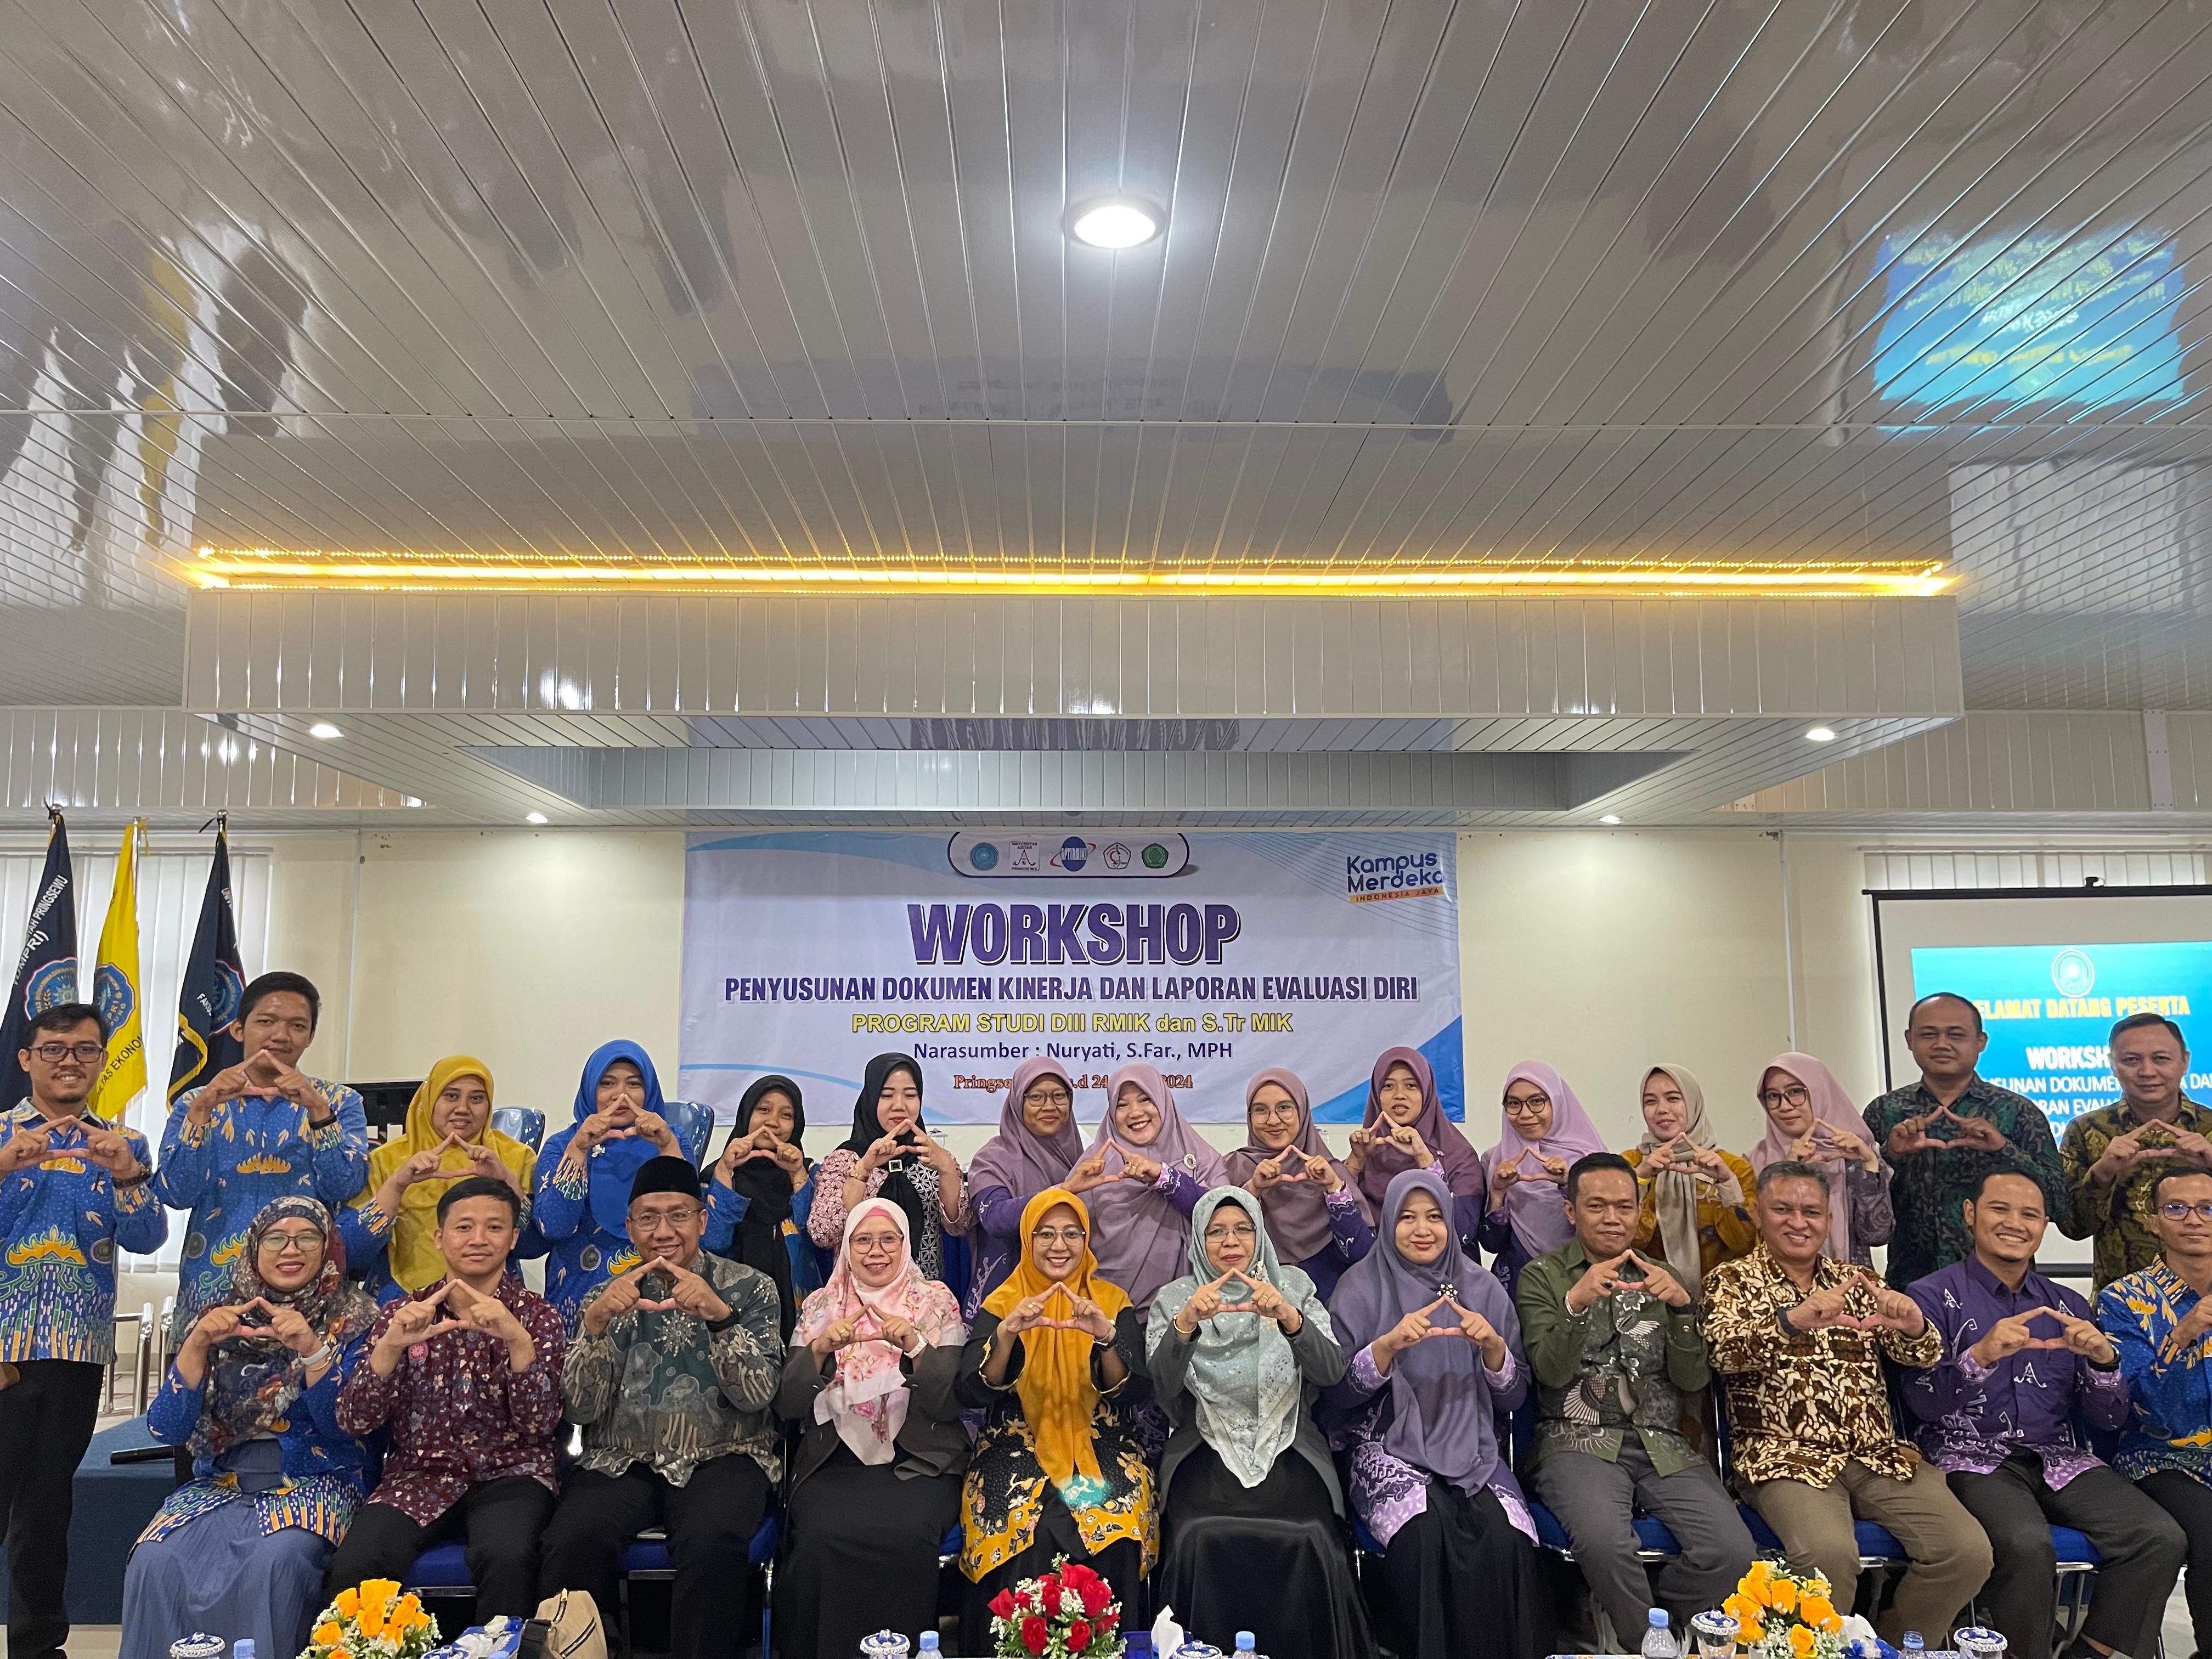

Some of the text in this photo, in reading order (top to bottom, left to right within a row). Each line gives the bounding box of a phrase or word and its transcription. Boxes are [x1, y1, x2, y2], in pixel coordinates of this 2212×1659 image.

[1347, 853, 1437, 874] Kampus
[1347, 868, 1444, 893] Merdeka
[33, 874, 69, 921] PRINGSEWU
[1356, 891, 1410, 901] INDONESIA
[907, 903, 1241, 965] WORKSHOP
[725, 977, 1417, 1001] PENYUSUNAN DOKUMEN KINERJA DAN LAPORAN EVALUASI DIRI
[1973, 995, 2191, 1019] ELAMAT DATANG PESERTA
[852, 1013, 1293, 1032] PROGRAM STUDI DIII RMIK dan S.Tr MIK
[111, 1034, 143, 1070] EKONO
[915, 1042, 1028, 1058] Narasumber
[1047, 1043, 1120, 1062] Nuryati,
[1127, 1042, 1181, 1061] S.Far.,
[1188, 1043, 1232, 1058] MPH
[2025, 1046, 2110, 1070] WORKSH
[953, 1075, 1013, 1093] Pringse
[1092, 1074, 1109, 1088] 24
